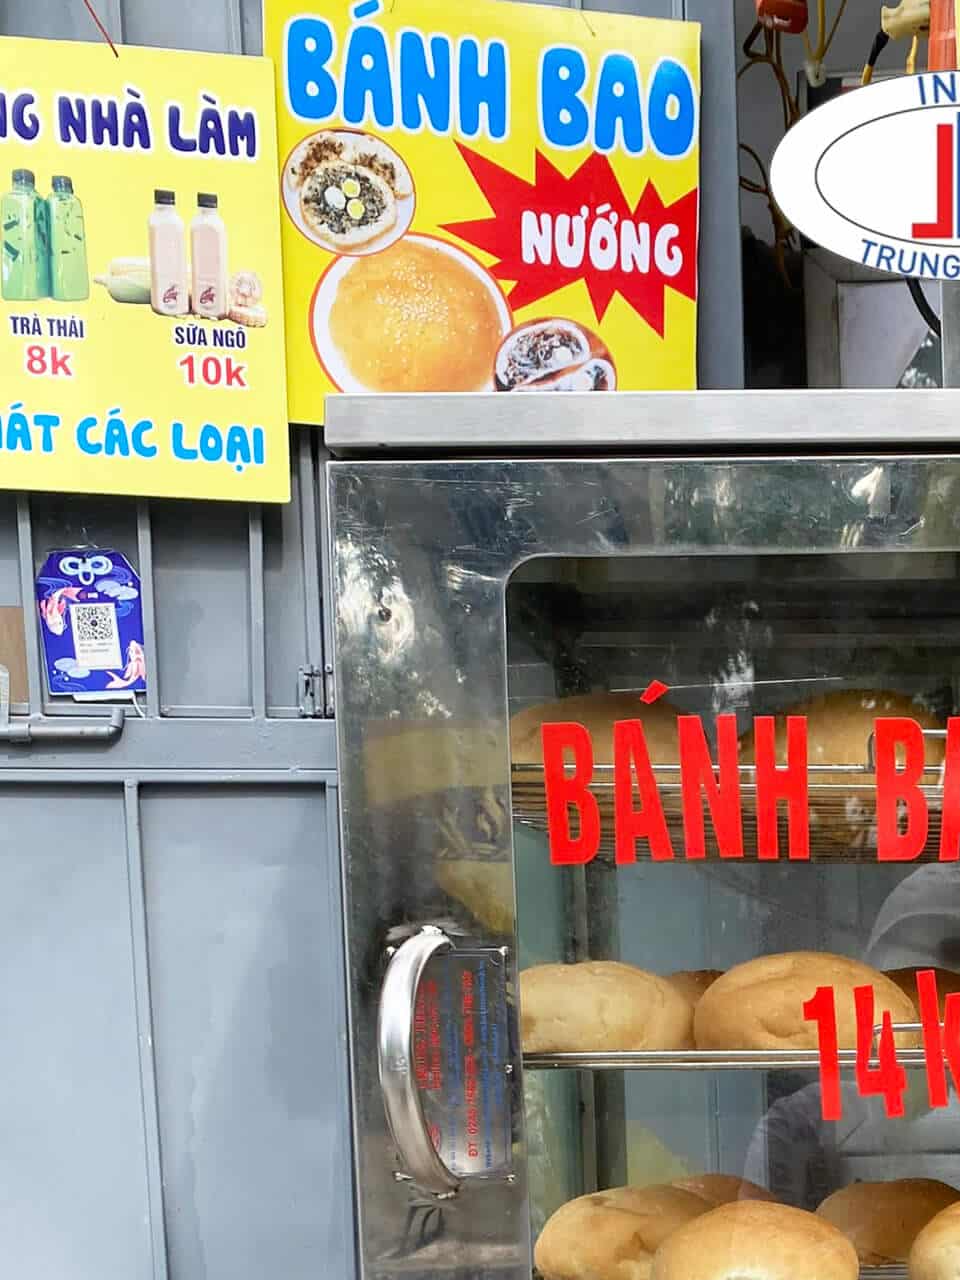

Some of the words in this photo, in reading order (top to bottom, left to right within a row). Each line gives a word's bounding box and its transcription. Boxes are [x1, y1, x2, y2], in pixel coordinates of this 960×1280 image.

[286, 0, 508, 139] BÁNH
[541, 47, 695, 157] BAO
[0, 93, 40, 140] G
[58, 88, 151, 149] NHÀ
[168, 94, 256, 157] LÀM
[521, 203, 683, 277] NƯỚNG
[10, 314, 42, 336] TRÀ
[47, 316, 85, 338] THÁI
[26, 345, 72, 376] 8k
[175, 323, 207, 346] SỮA
[213, 328, 247, 349] NGÔ
[179, 354, 247, 387] 10k
[0, 402, 60, 453] ÁT
[76, 408, 158, 458] CÁC
[172, 422, 265, 472] LOẠI
[541, 681, 810, 866] BÁNH
